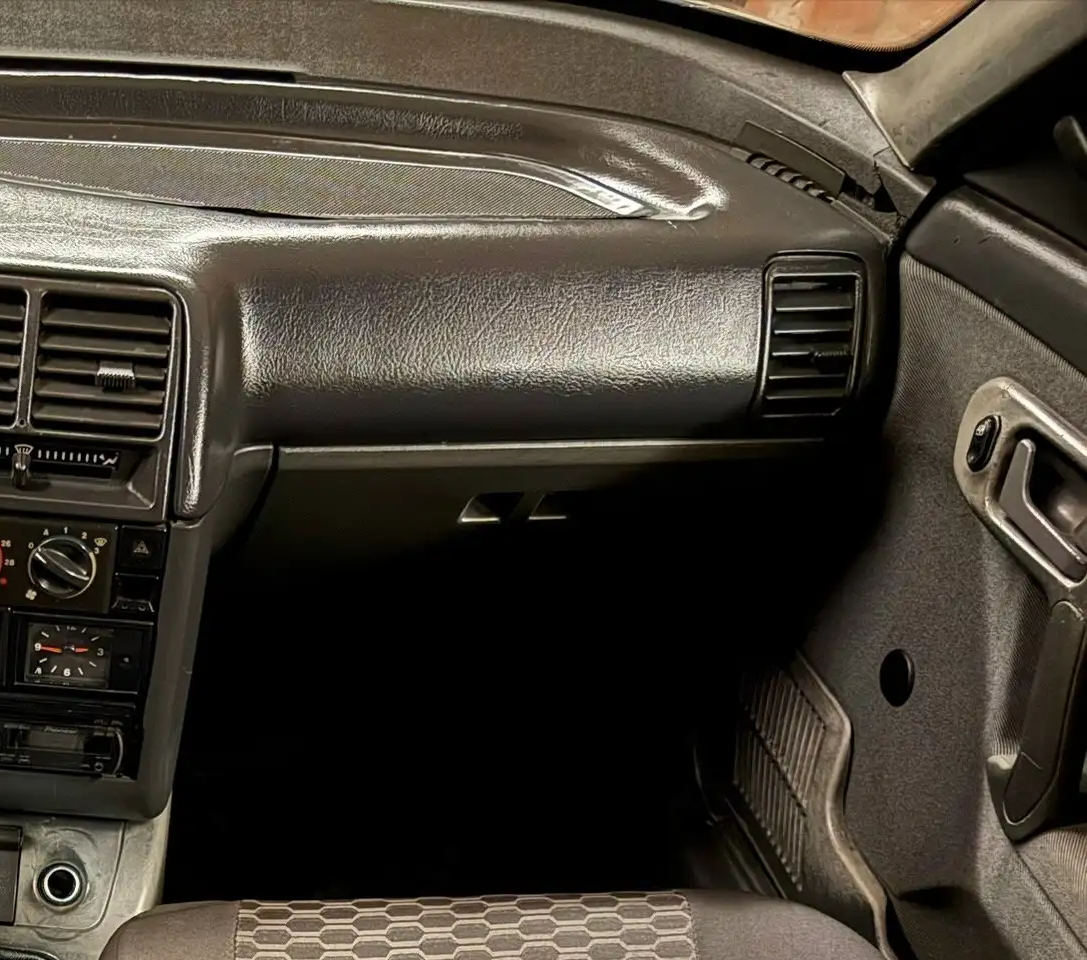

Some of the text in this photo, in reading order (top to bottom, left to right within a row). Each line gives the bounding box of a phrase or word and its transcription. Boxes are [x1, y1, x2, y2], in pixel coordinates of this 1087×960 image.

[63, 526, 68, 534] 1
[81, 531, 88, 540] 2
[1, 540, 11, 548] 26
[94, 547, 100, 555] 3
[34, 642, 42, 652] 9
[97, 648, 104, 657] 3
[63, 668, 71, 677] 6
